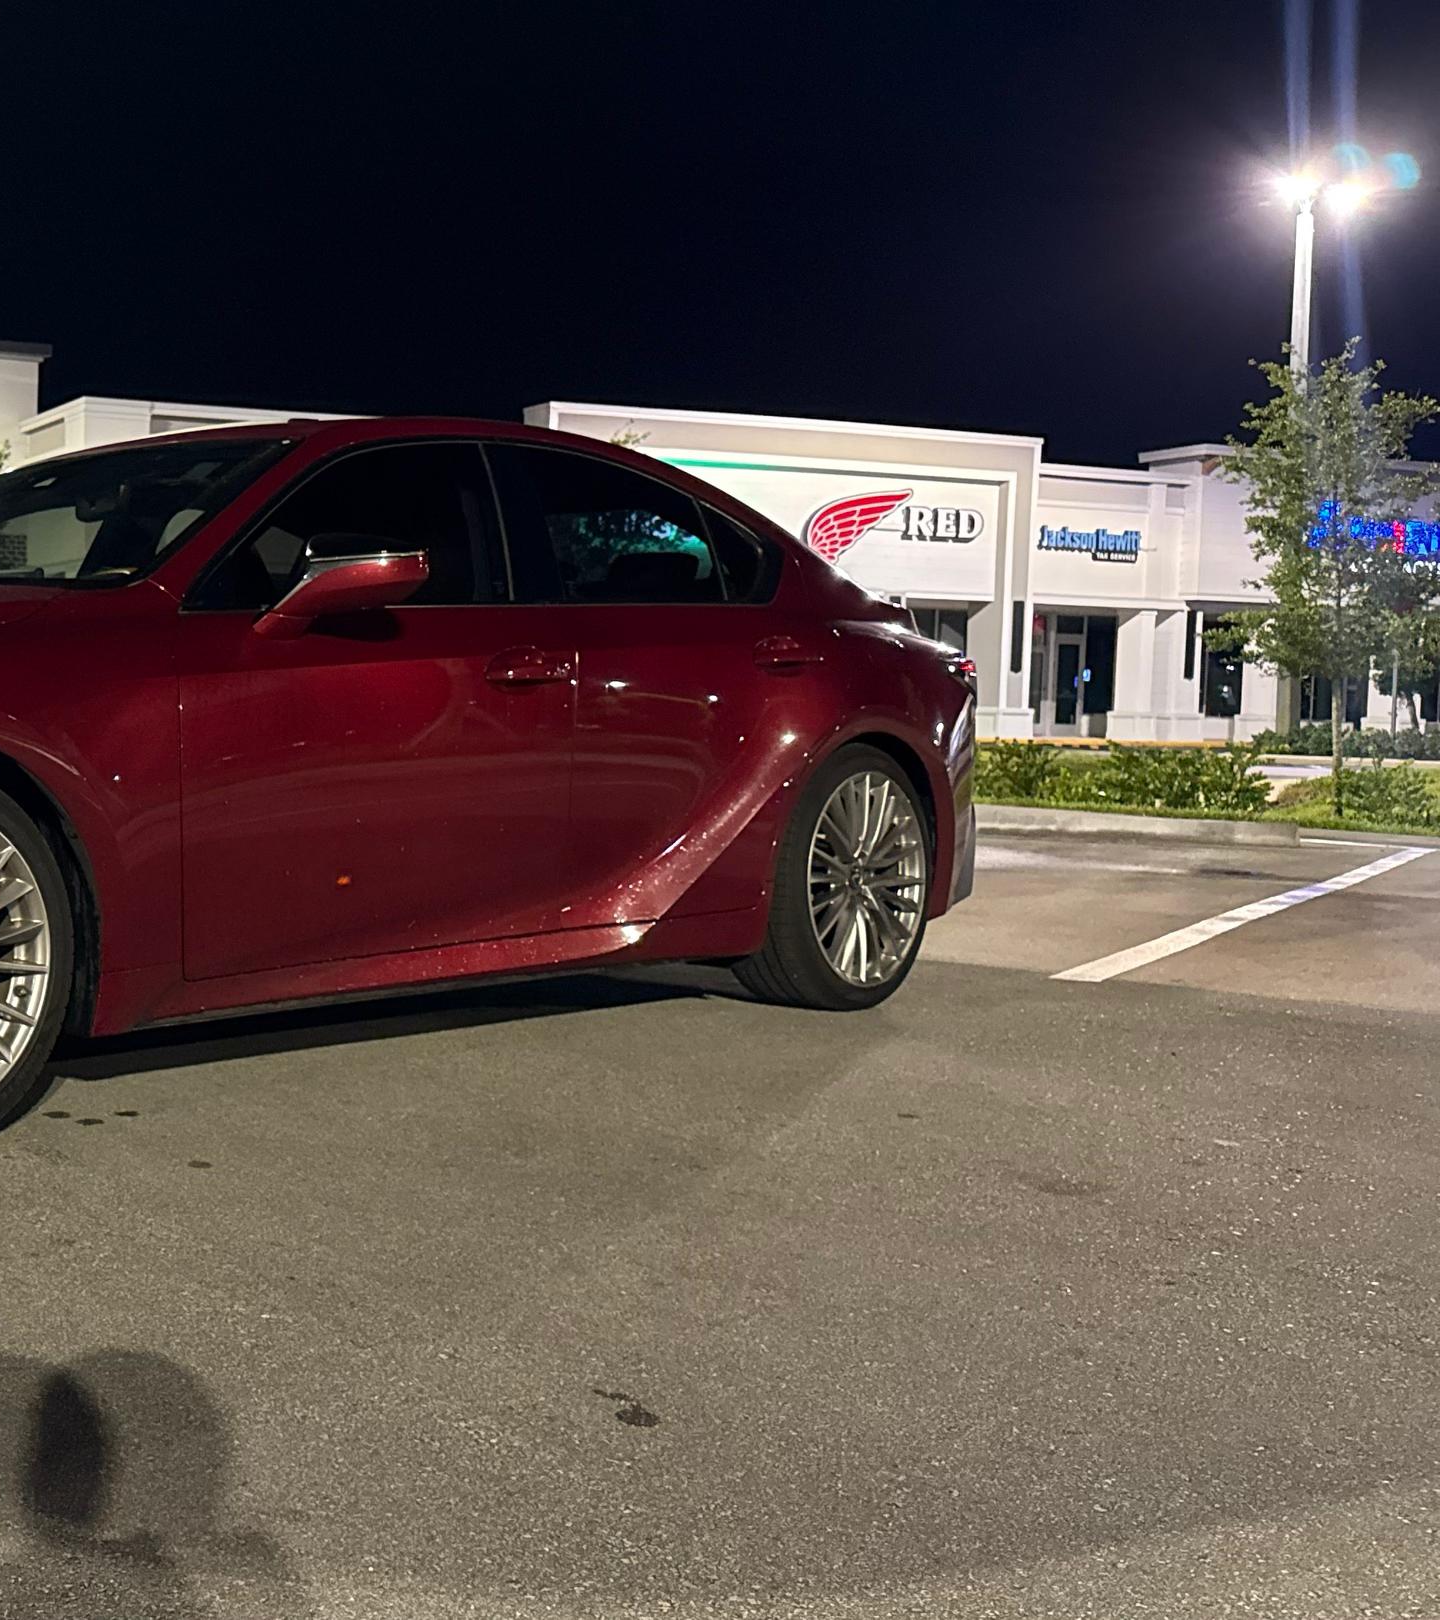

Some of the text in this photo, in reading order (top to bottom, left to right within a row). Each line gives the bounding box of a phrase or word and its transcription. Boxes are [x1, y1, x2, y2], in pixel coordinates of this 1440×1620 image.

[901, 506, 984, 543] RED
[1038, 525, 1141, 555] Jackson Hewitt
[1096, 552, 1136, 561] TAX SERVICE
